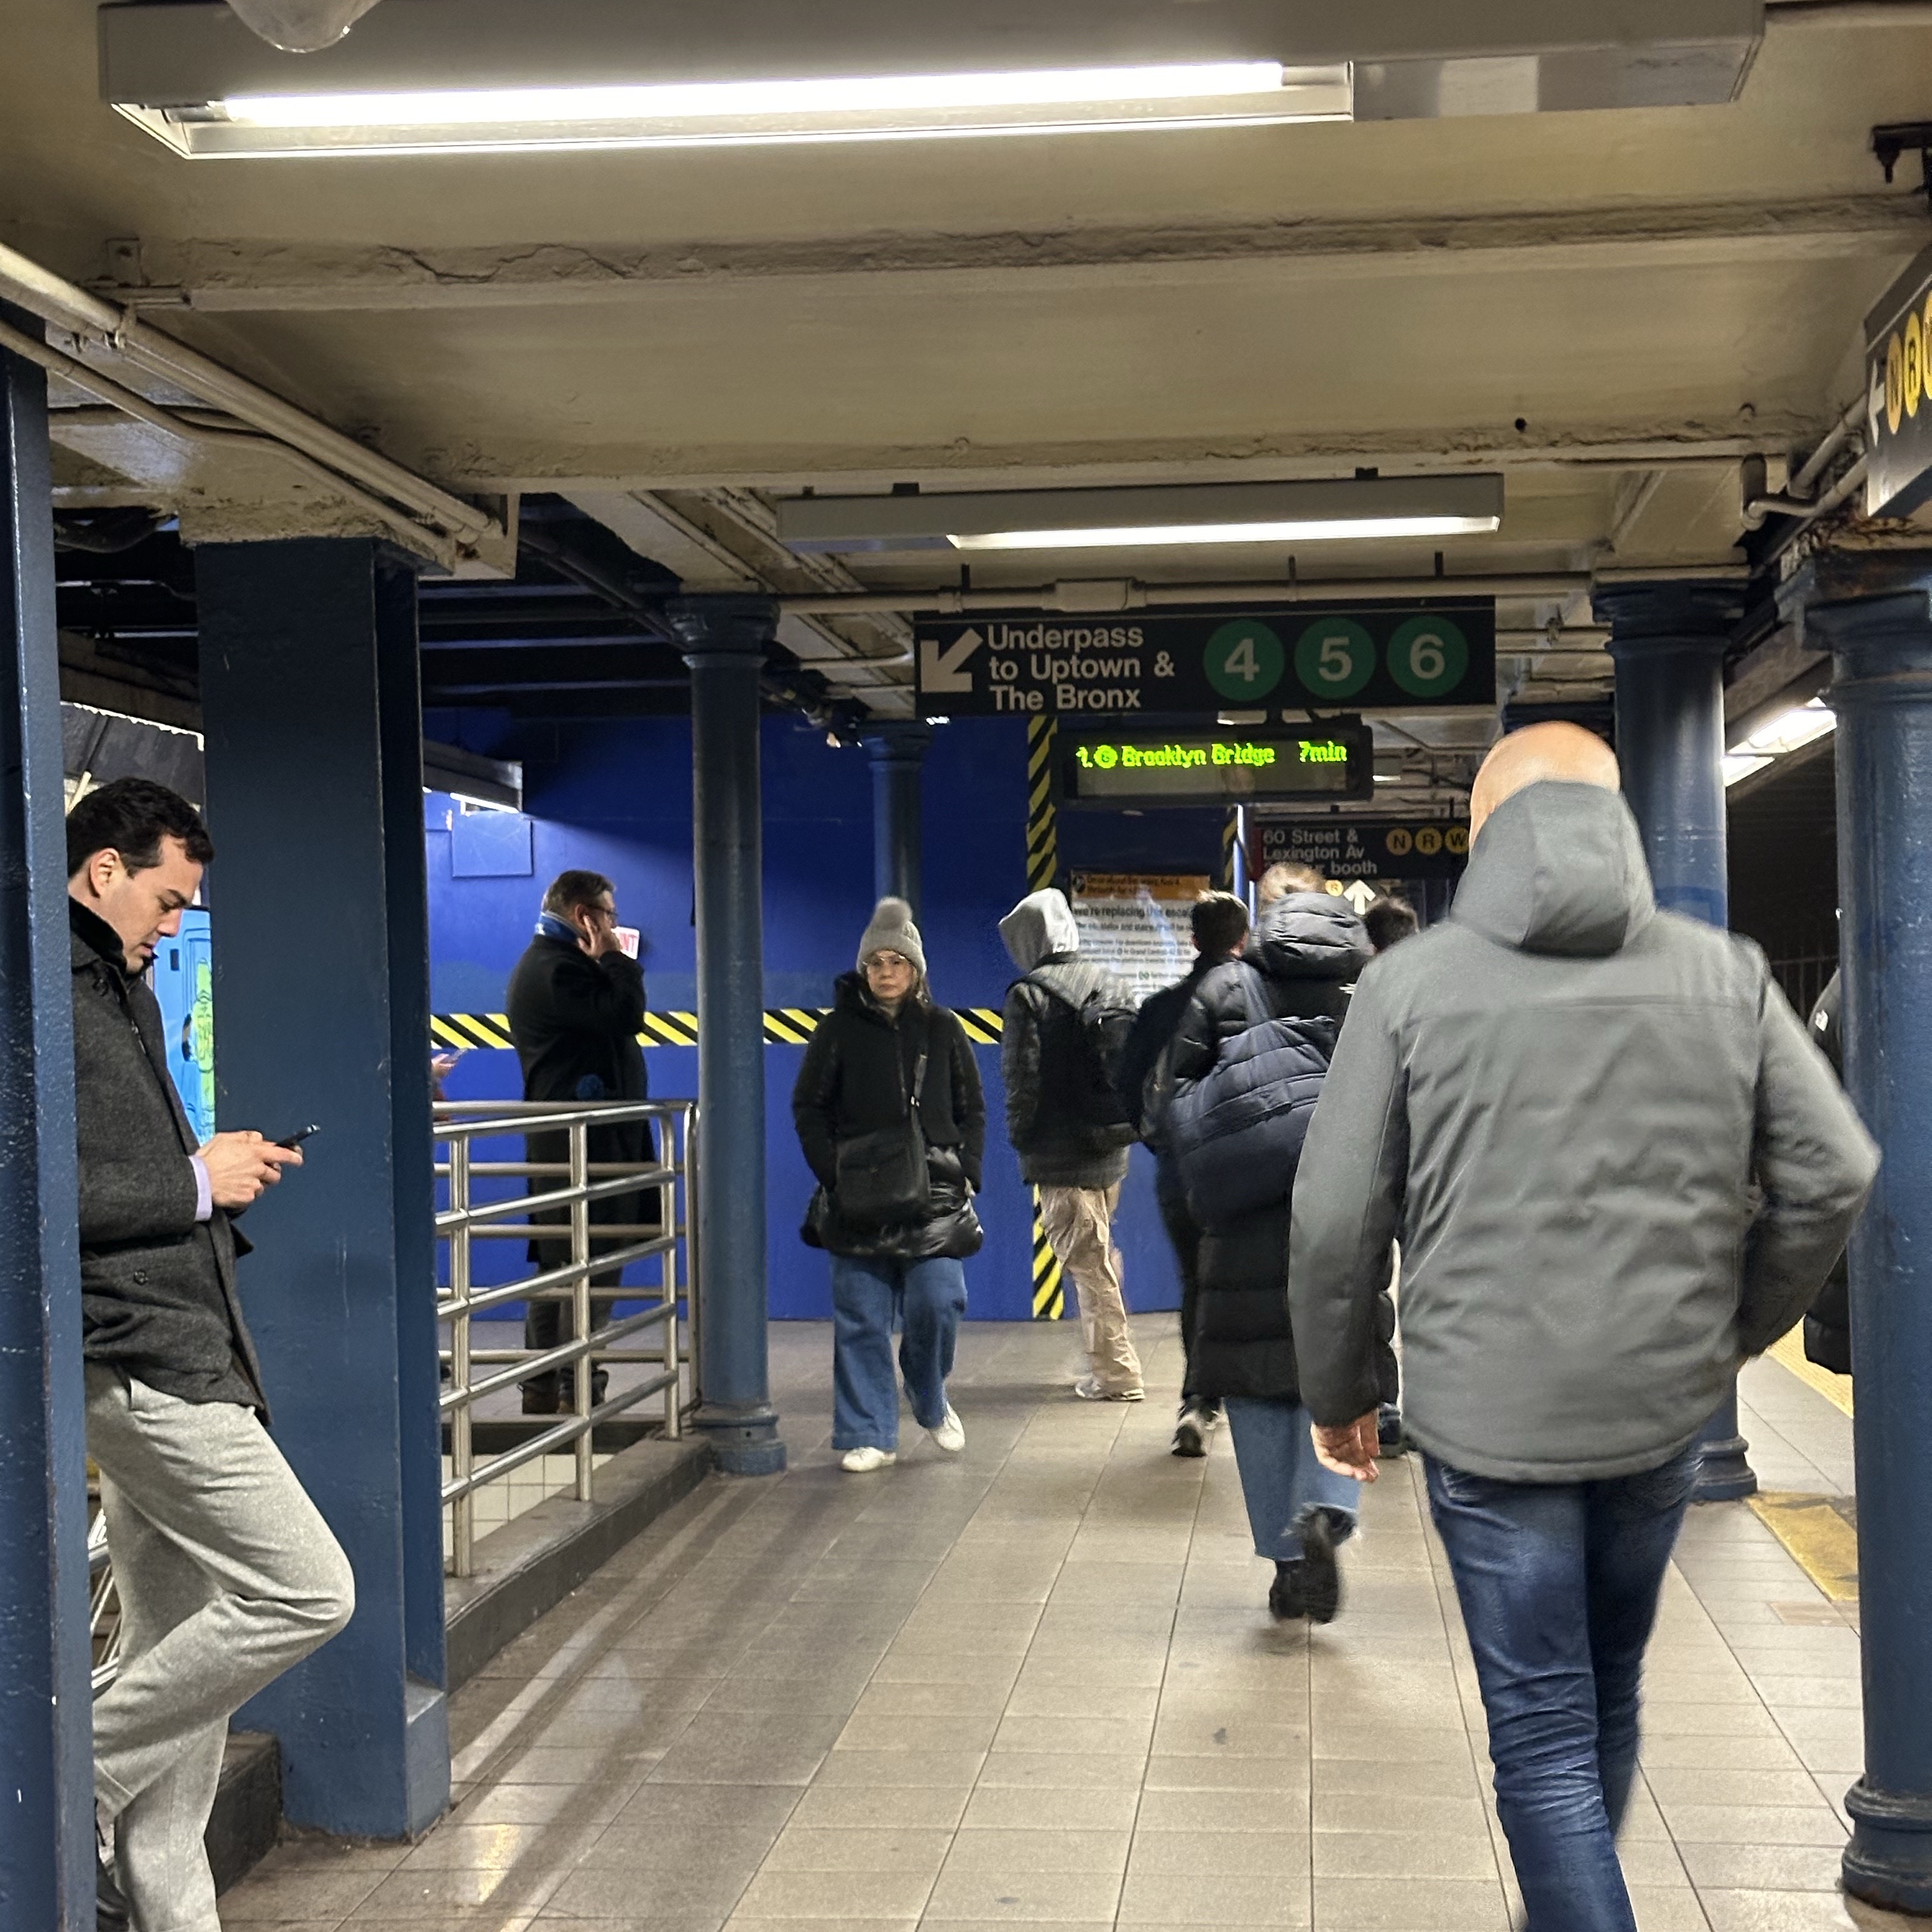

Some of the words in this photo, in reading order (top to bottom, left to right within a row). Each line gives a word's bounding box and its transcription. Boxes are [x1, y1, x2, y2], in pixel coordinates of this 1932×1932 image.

[1908, 337, 1916, 392] R
[988, 624, 1144, 653] Underpass
[990, 656, 1018, 680] to
[1031, 654, 1141, 684] Uptown
[1154, 650, 1175, 677] &
[1224, 639, 1260, 682] 4
[1319, 637, 1353, 682] 5
[1410, 634, 1445, 680] 6
[990, 685, 1044, 710] The
[1057, 684, 1141, 710] Bronx
[1121, 745, 1207, 769] Brooklyn
[1211, 743, 1275, 767] Bridge
[1263, 829, 1285, 844] 60
[1291, 829, 1340, 844] Street
[1346, 827, 1358, 843] &
[1393, 834, 1406, 849] N
[1422, 834, 1434, 848] R
[1449, 833, 1466, 847] W
[1262, 845, 1340, 862] Lexington
[1345, 847, 1365, 859] Av
[1331, 861, 1377, 875] booth
[1101, 905, 1144, 919] replacing
